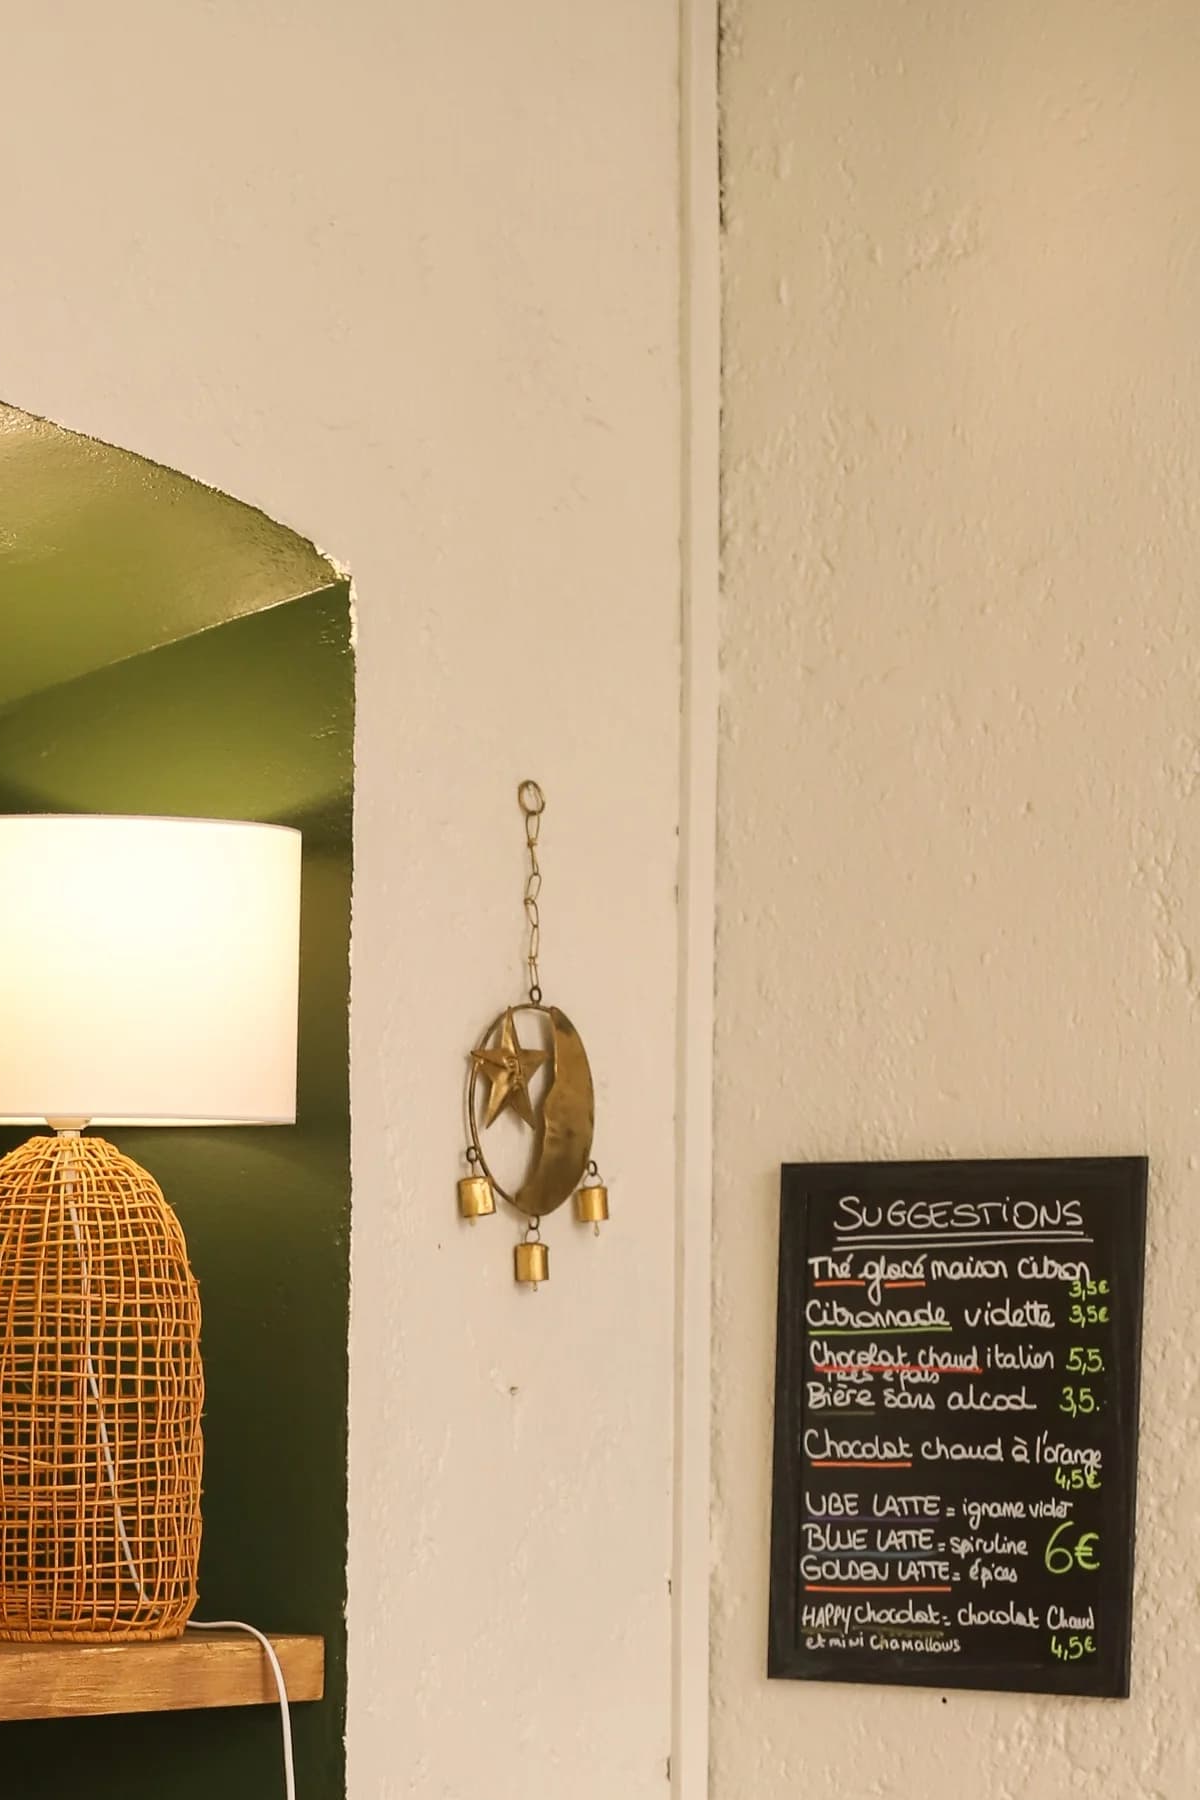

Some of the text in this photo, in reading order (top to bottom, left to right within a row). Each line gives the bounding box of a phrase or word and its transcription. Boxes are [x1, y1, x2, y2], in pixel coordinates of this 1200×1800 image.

[833, 1196, 1084, 1231] SUGGESTIONS
[808, 1254, 854, 1279] Thé
[931, 1256, 1009, 1280] maison
[805, 1300, 951, 1328] Citronnade
[810, 1341, 911, 1368] Chocolat
[917, 1345, 979, 1369] chaud
[986, 1344, 1055, 1369] italien
[806, 1381, 876, 1409] Bière
[803, 1428, 913, 1460] Chocolat
[921, 1436, 1004, 1462] chaud
[1011, 1436, 1030, 1465] à
[805, 1491, 859, 1517] UBE
[873, 1495, 940, 1517] LATTE
[802, 1524, 868, 1551] BLUE
[876, 1528, 934, 1551] LATTE
[1044, 1520, 1100, 1574] 6€
[800, 1555, 888, 1581] GOLDEN
[899, 1560, 950, 1582] LATTE
[802, 1603, 853, 1634] HAPPY
